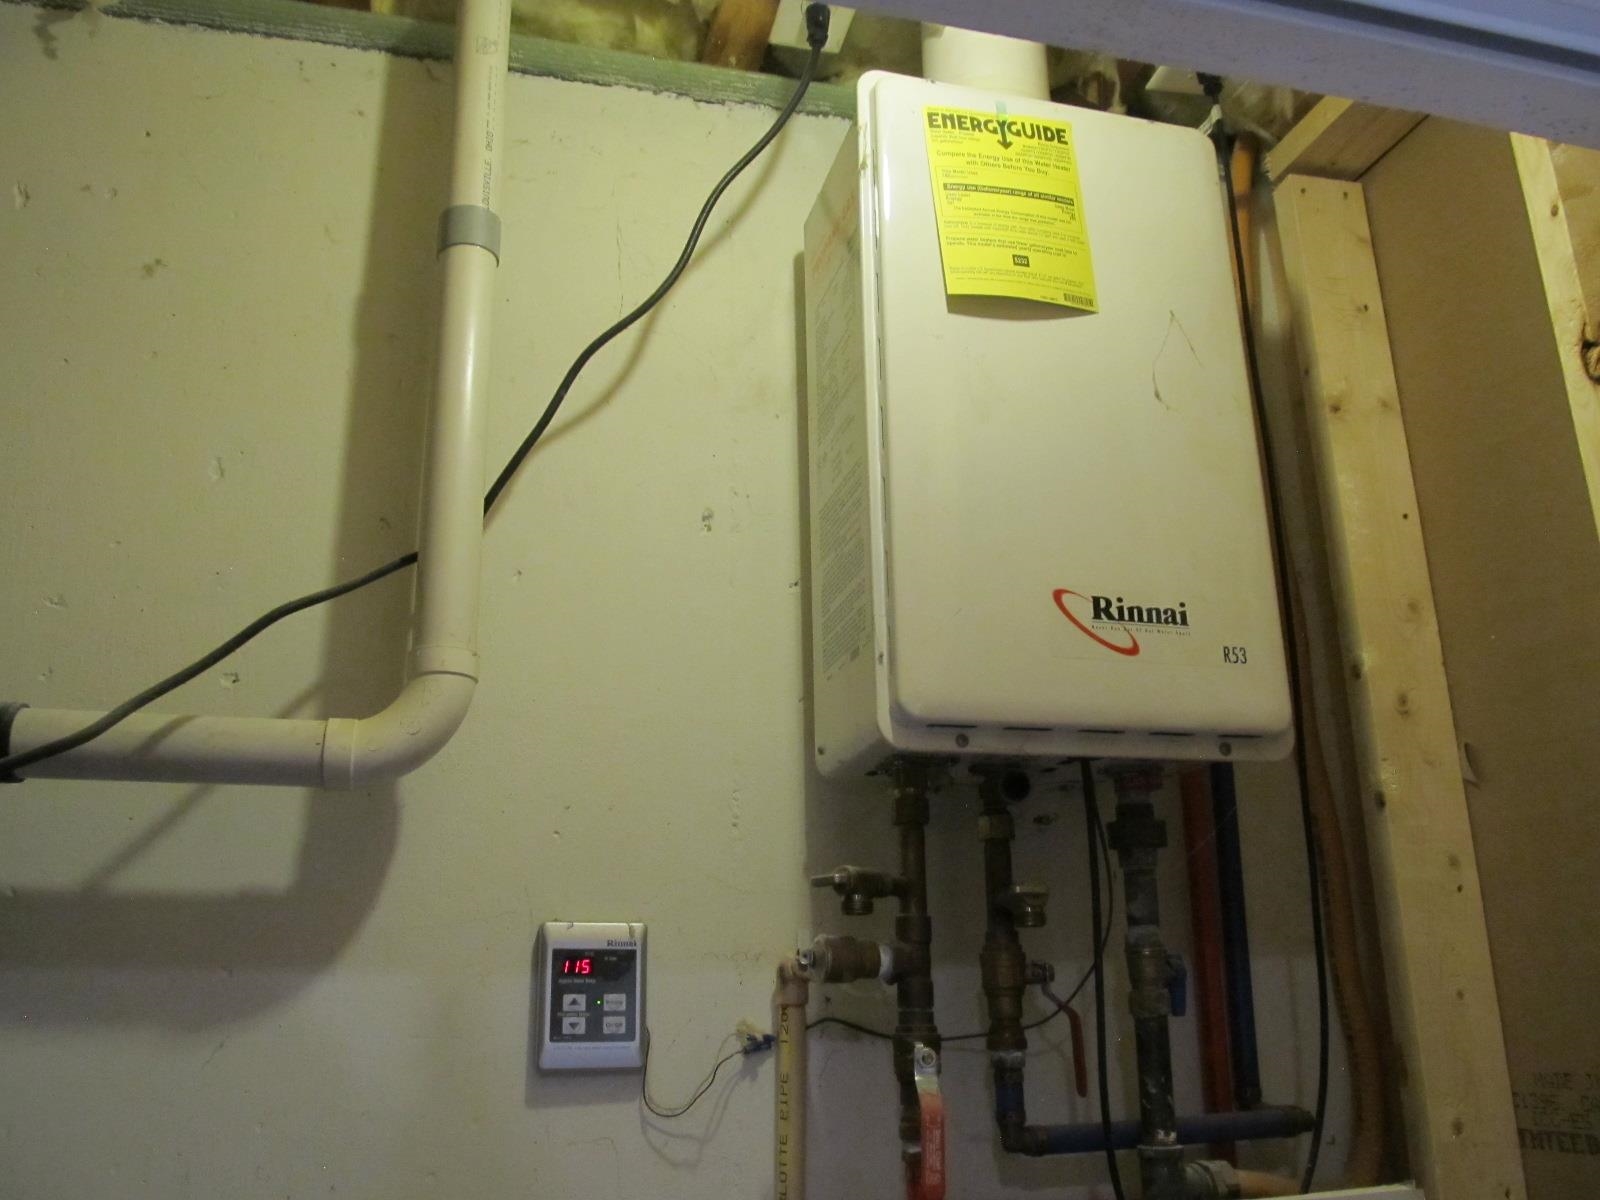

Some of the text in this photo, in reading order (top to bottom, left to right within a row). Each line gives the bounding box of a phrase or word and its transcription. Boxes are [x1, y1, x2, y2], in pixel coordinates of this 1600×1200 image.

[927, 112, 1069, 149] ENERGYGUIDE
[1091, 595, 1190, 626] Rinnai
[1223, 646, 1248, 665] R53
[606, 939, 637, 948] Rinnai
[563, 959, 592, 974] 115
[779, 1072, 789, 1121] PIPE
